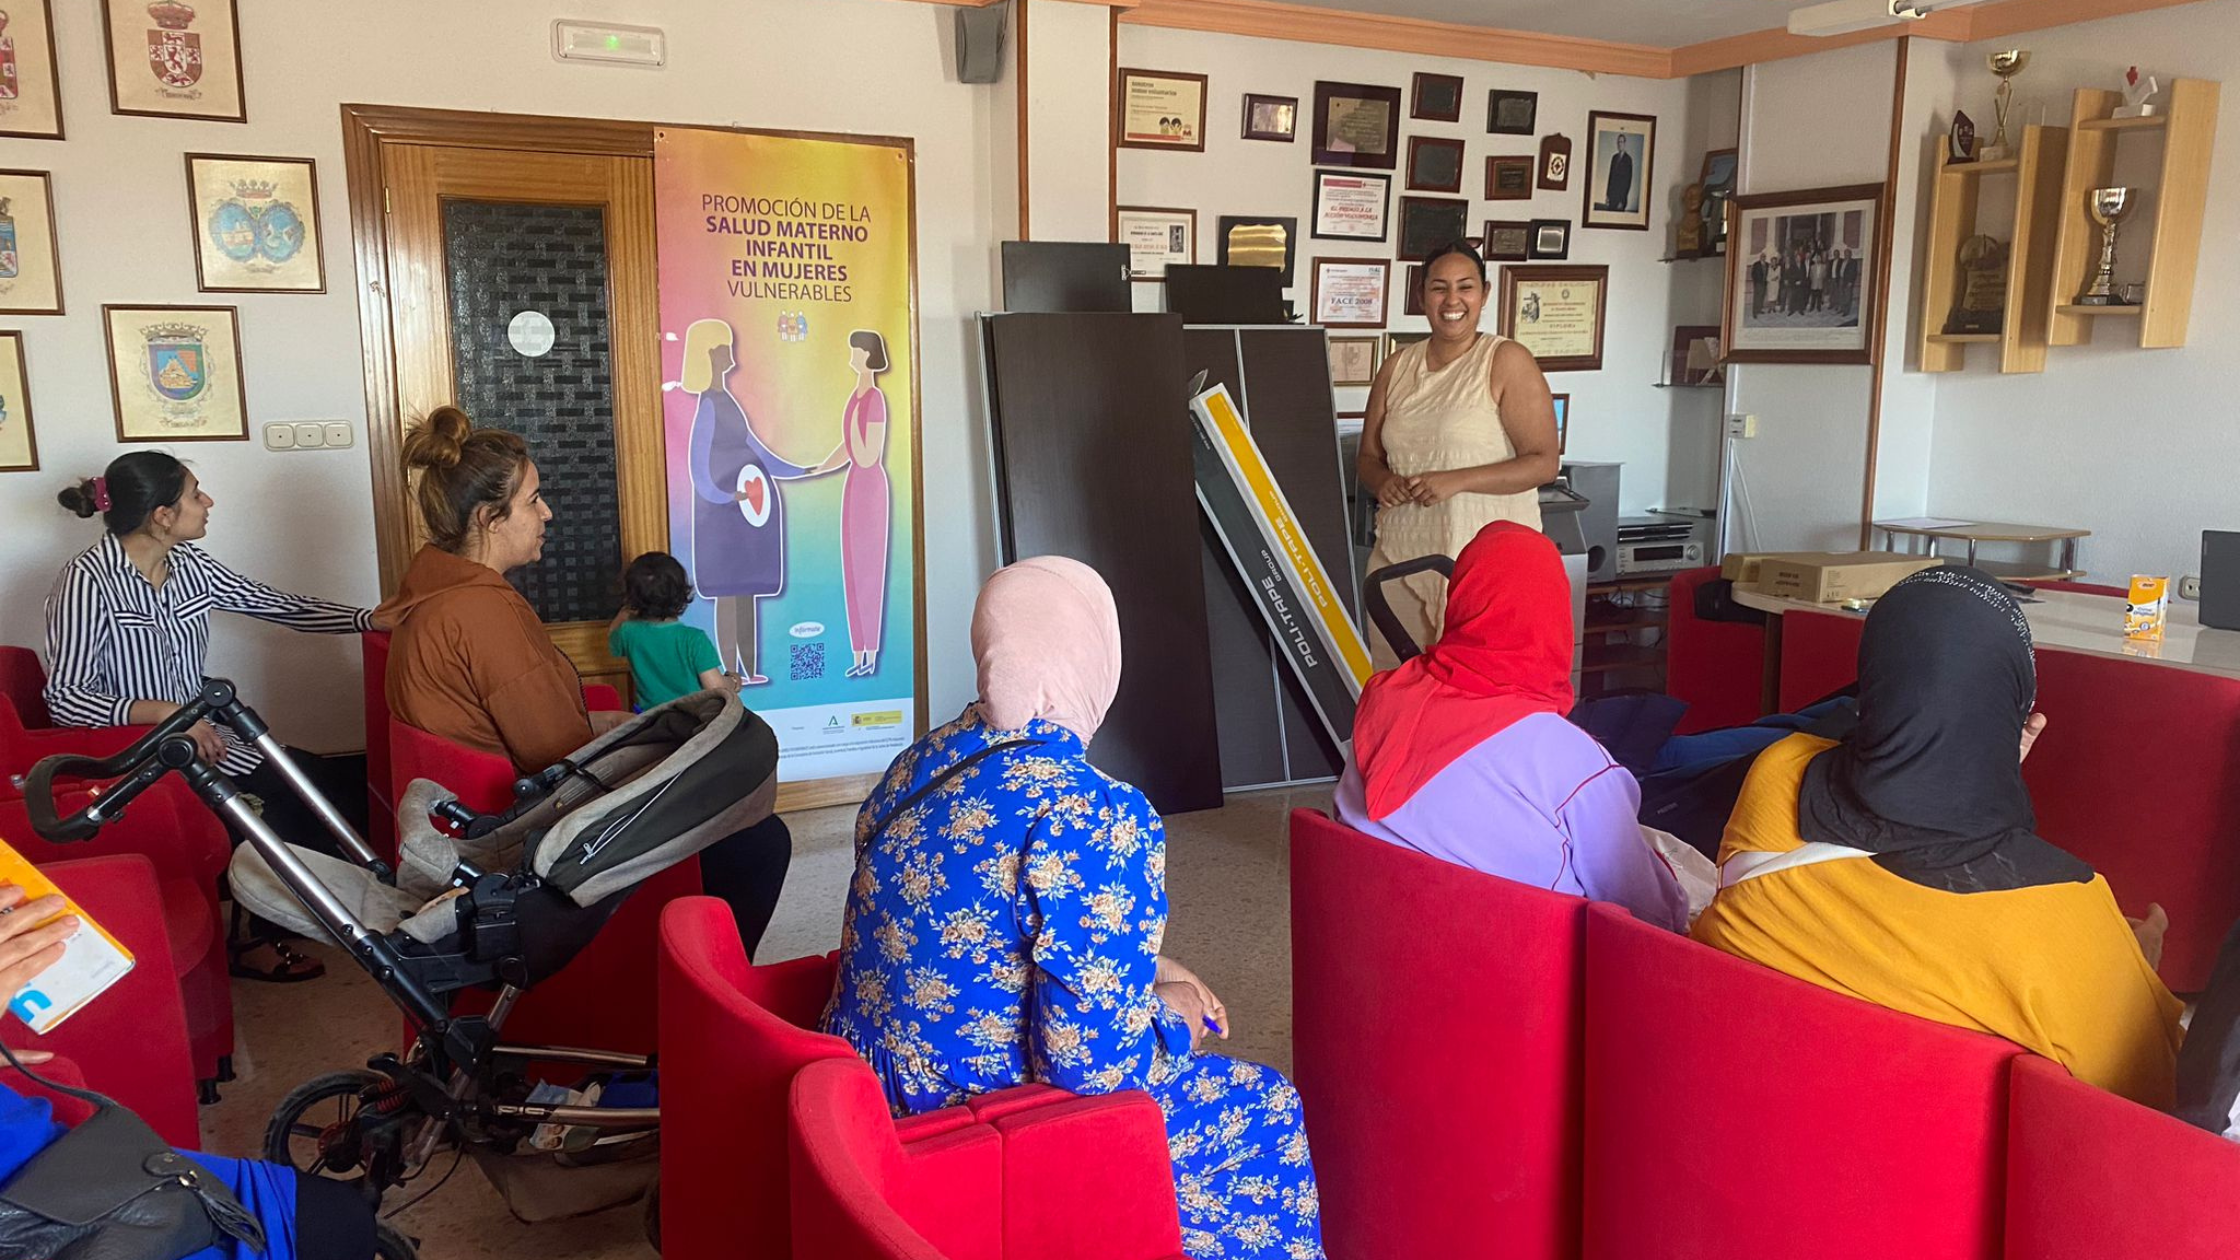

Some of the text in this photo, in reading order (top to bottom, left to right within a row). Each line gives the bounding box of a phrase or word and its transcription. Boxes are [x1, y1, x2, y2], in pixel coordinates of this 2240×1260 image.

[701, 194, 872, 223] PROMOCIÓN DE LA
[706, 215, 868, 243] SALUD MATERNO
[746, 239, 833, 261] INFANTIL
[731, 259, 848, 282] EN MUJERES
[727, 280, 853, 303] VULNERABLES
[1330, 296, 1354, 305] FACE
[1260, 549, 1282, 582] GROUP
